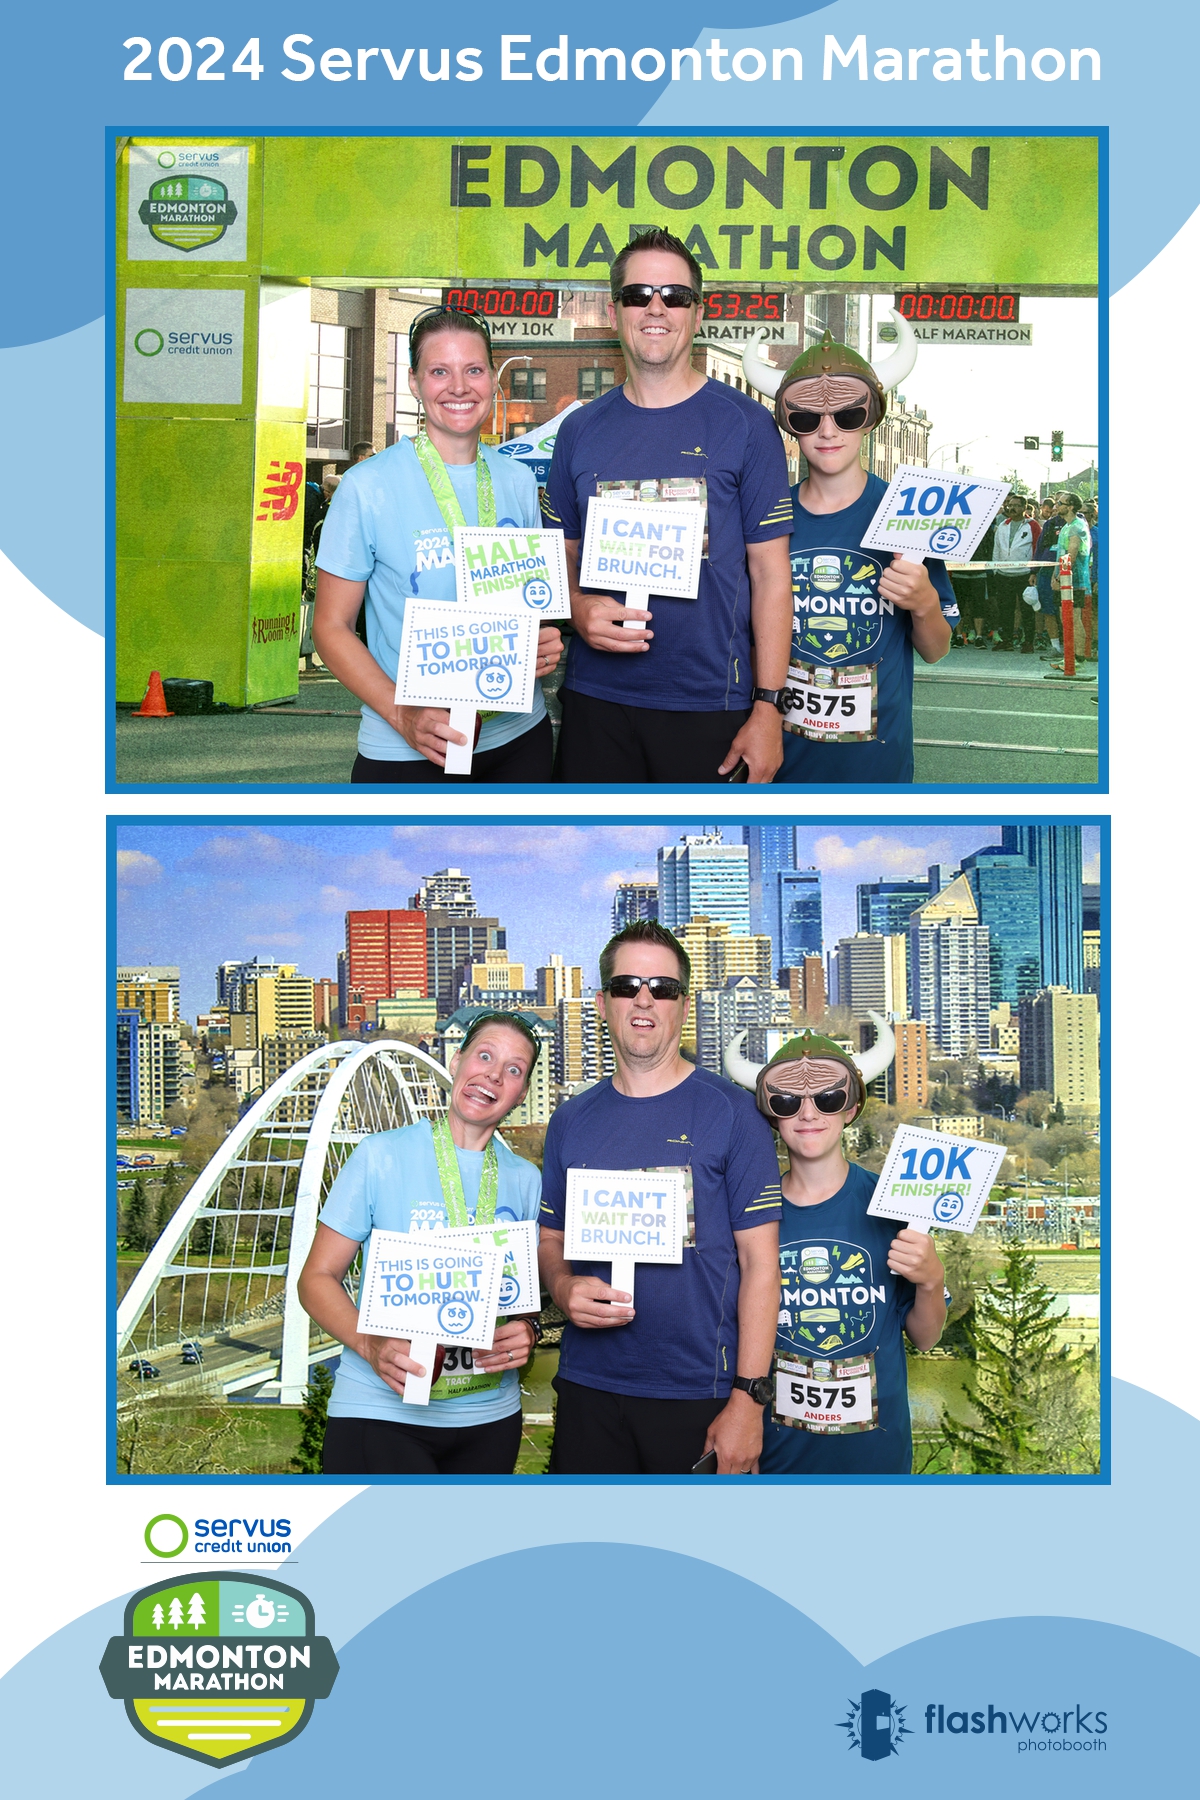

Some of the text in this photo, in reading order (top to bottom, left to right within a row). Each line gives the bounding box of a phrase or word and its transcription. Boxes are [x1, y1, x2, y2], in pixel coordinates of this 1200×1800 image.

[178, 152, 219, 160] servus
[451, 145, 990, 211] EDMONTON
[150, 203, 226, 214] EDMONTON
[492, 322, 554, 336] MY 10K
[694, 326, 784, 340] ARATHON
[914, 328, 1030, 340] ALF MARATHON
[168, 332, 233, 344] servus
[168, 345, 200, 355] credit
[896, 484, 980, 516] 10K
[601, 518, 687, 542] I CAN'T
[885, 518, 971, 531] FINISHER!
[414, 536, 450, 551] 2024
[464, 534, 542, 569] HALF
[599, 540, 684, 562] WAIT FOR
[470, 556, 546, 581] MARATHON
[598, 557, 682, 580] BRUNCH.
[472, 567, 550, 597] FINISHER!
[794, 595, 894, 616] MONTON
[413, 618, 519, 641] THIS IS GOING
[417, 633, 518, 661] TO HURT
[417, 653, 522, 676] TOMORROW.
[792, 687, 856, 717] 5575
[803, 718, 840, 729] ANDERS
[804, 730, 824, 739] ARMY
[900, 1146, 976, 1180] 10K
[891, 1183, 971, 1197] FINISHER!
[582, 1189, 667, 1209] I CAN'T
[410, 1209, 445, 1220] 2024
[581, 1211, 666, 1228] WAIT FOR
[581, 1228, 666, 1246] BRUNCH.
[378, 1256, 483, 1273] THIS IS GOING
[381, 1270, 482, 1292] TO HURT
[380, 1290, 484, 1307] TOMORROW.
[780, 1285, 886, 1306] MONTON
[446, 1376, 472, 1386] TRACY
[463, 1383, 491, 1392] MARATHON
[791, 1382, 856, 1409] 5575
[804, 1411, 842, 1421] ANDERS
